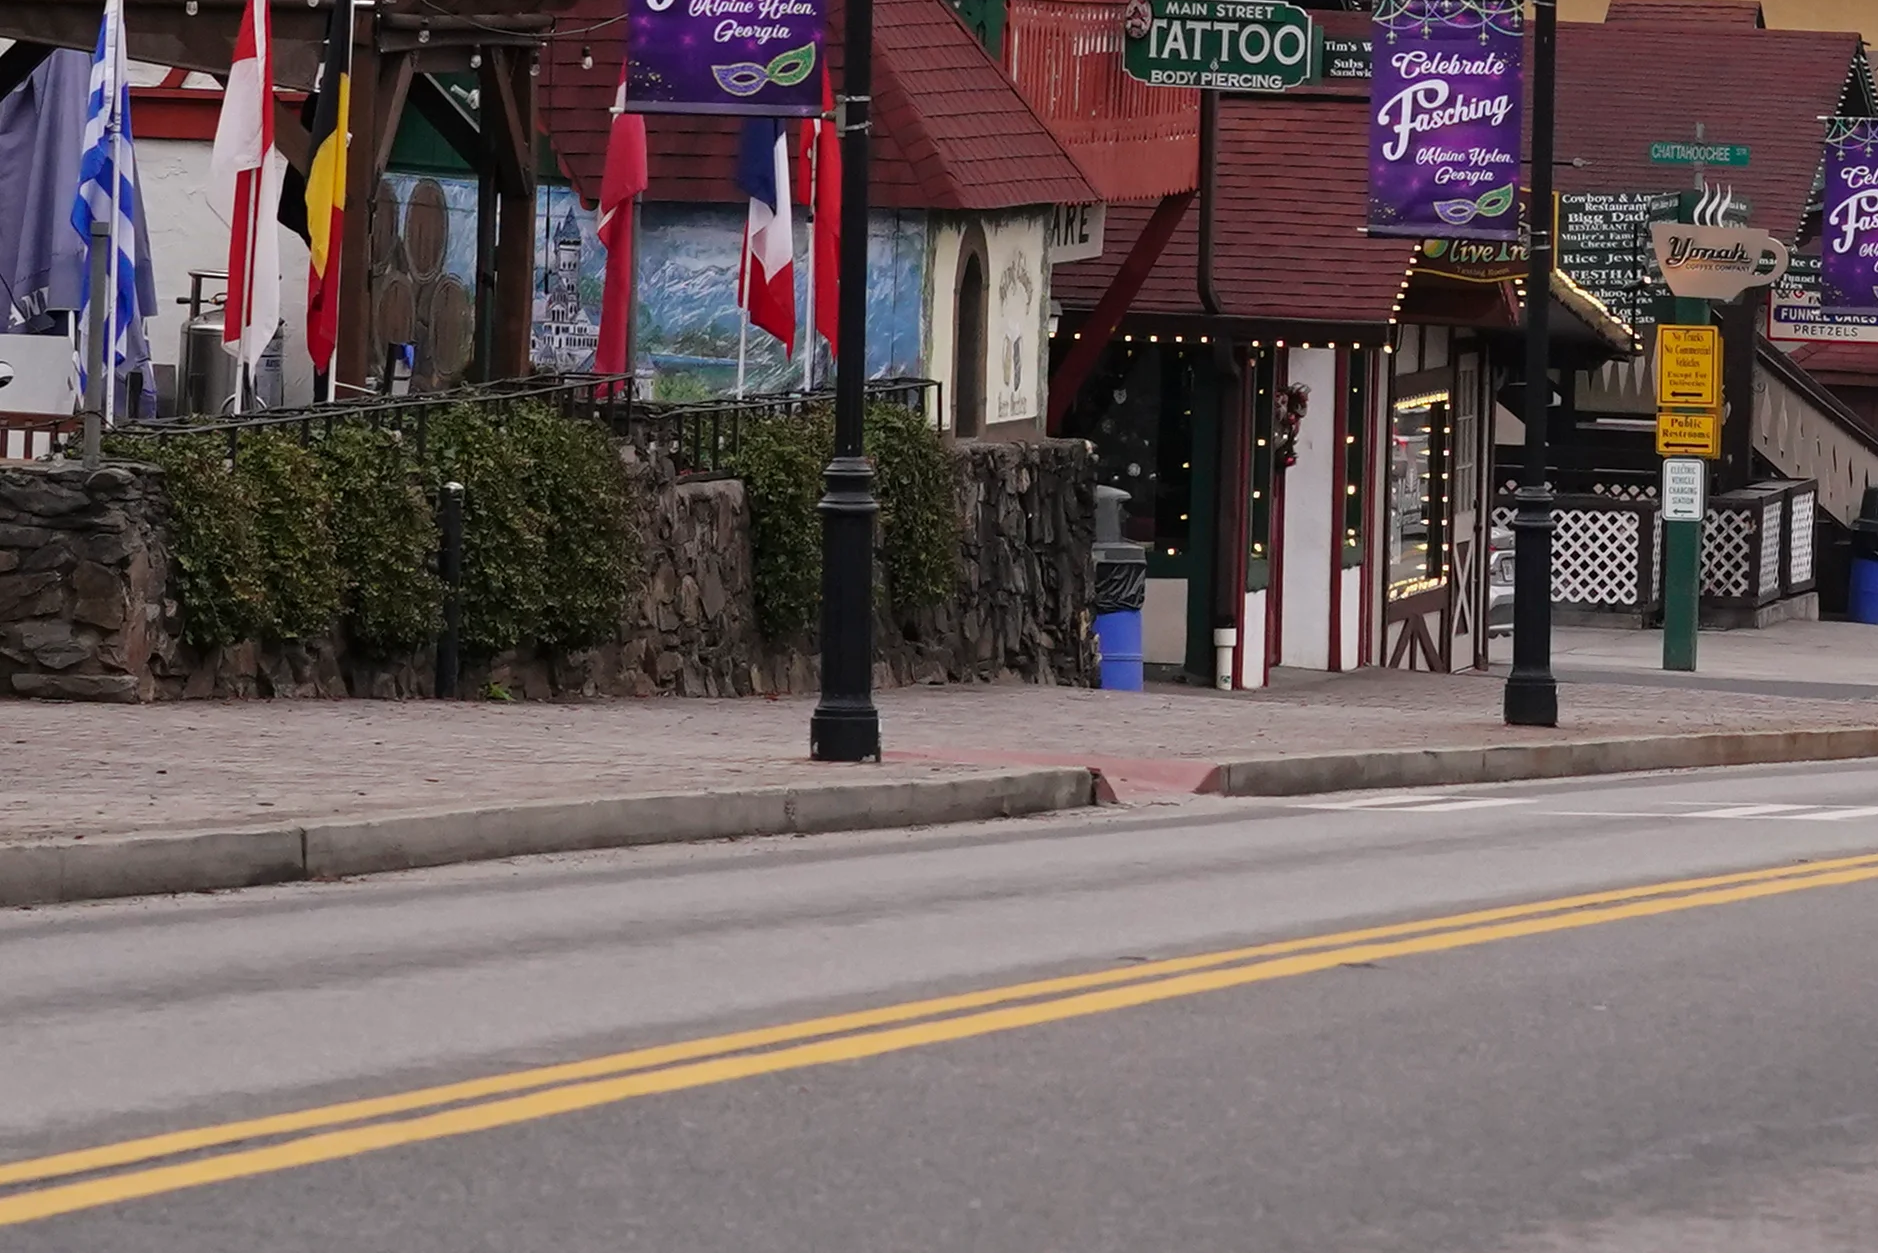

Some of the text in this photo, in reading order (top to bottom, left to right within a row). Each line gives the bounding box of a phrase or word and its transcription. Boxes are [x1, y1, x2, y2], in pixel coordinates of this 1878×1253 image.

[1165, 1, 1275, 20] MAIN STREET
[714, 19, 791, 44] Georgia
[1149, 19, 1306, 66] TATTOO
[1324, 40, 1358, 52] Tim's
[1333, 58, 1364, 69] Subs
[1392, 51, 1506, 79] Celebrate
[1151, 69, 1283, 89] BODY PIERCING
[1377, 79, 1514, 161] Fasching
[1415, 147, 1465, 165] Alpine
[1652, 145, 1731, 162] CHATTAHOOCHEE
[1434, 166, 1495, 185] Georgia
[1562, 193, 1614, 205] Cowboys
[1618, 193, 1629, 203] &
[1584, 202, 1648, 212] Restaurant
[1050, 203, 1092, 247] ARE
[1567, 213, 1604, 225] Bigg
[1568, 223, 1630, 232] RESTAURANT
[1580, 240, 1618, 248] Cheese
[1563, 253, 1598, 264] Rice
[1666, 235, 1752, 270] Yonah
[1715, 263, 1750, 272] COMPANY
[1791, 258, 1806, 268] Ice
[1781, 307, 1831, 322] FUNNEL
[1793, 324, 1859, 337] PRETZELS
[1670, 418, 1702, 429] Public
[1662, 428, 1710, 439] Restrooms
